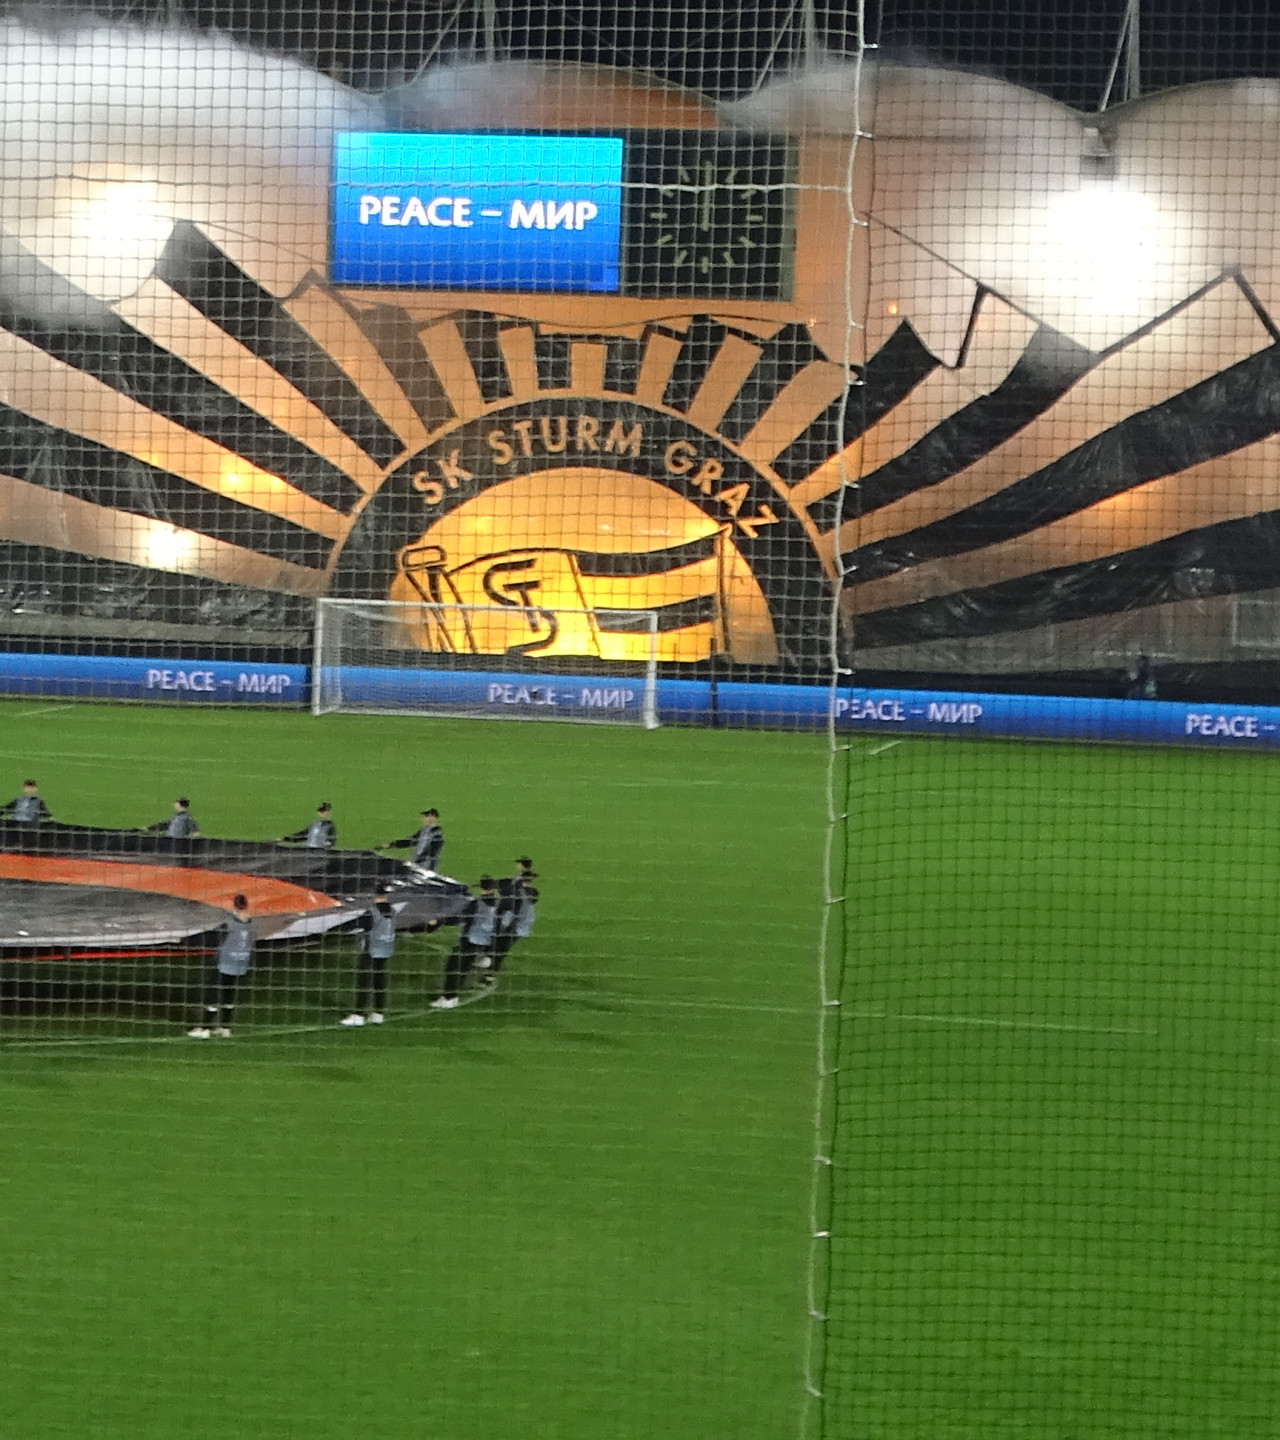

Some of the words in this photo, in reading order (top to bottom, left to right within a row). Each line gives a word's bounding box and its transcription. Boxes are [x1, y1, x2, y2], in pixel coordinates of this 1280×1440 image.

[360, 194, 474, 227] PEACE
[508, 199, 598, 230] МИР
[412, 449, 474, 505] SK
[486, 414, 643, 466] STURM
[664, 440, 780, 539] GRAZ
[146, 668, 217, 691] PEACE
[238, 672, 291, 694] МИР
[581, 687, 634, 708] МИР
[835, 698, 906, 721] PEACE
[927, 702, 983, 724] МИР
[1185, 713, 1259, 737] PEACE
